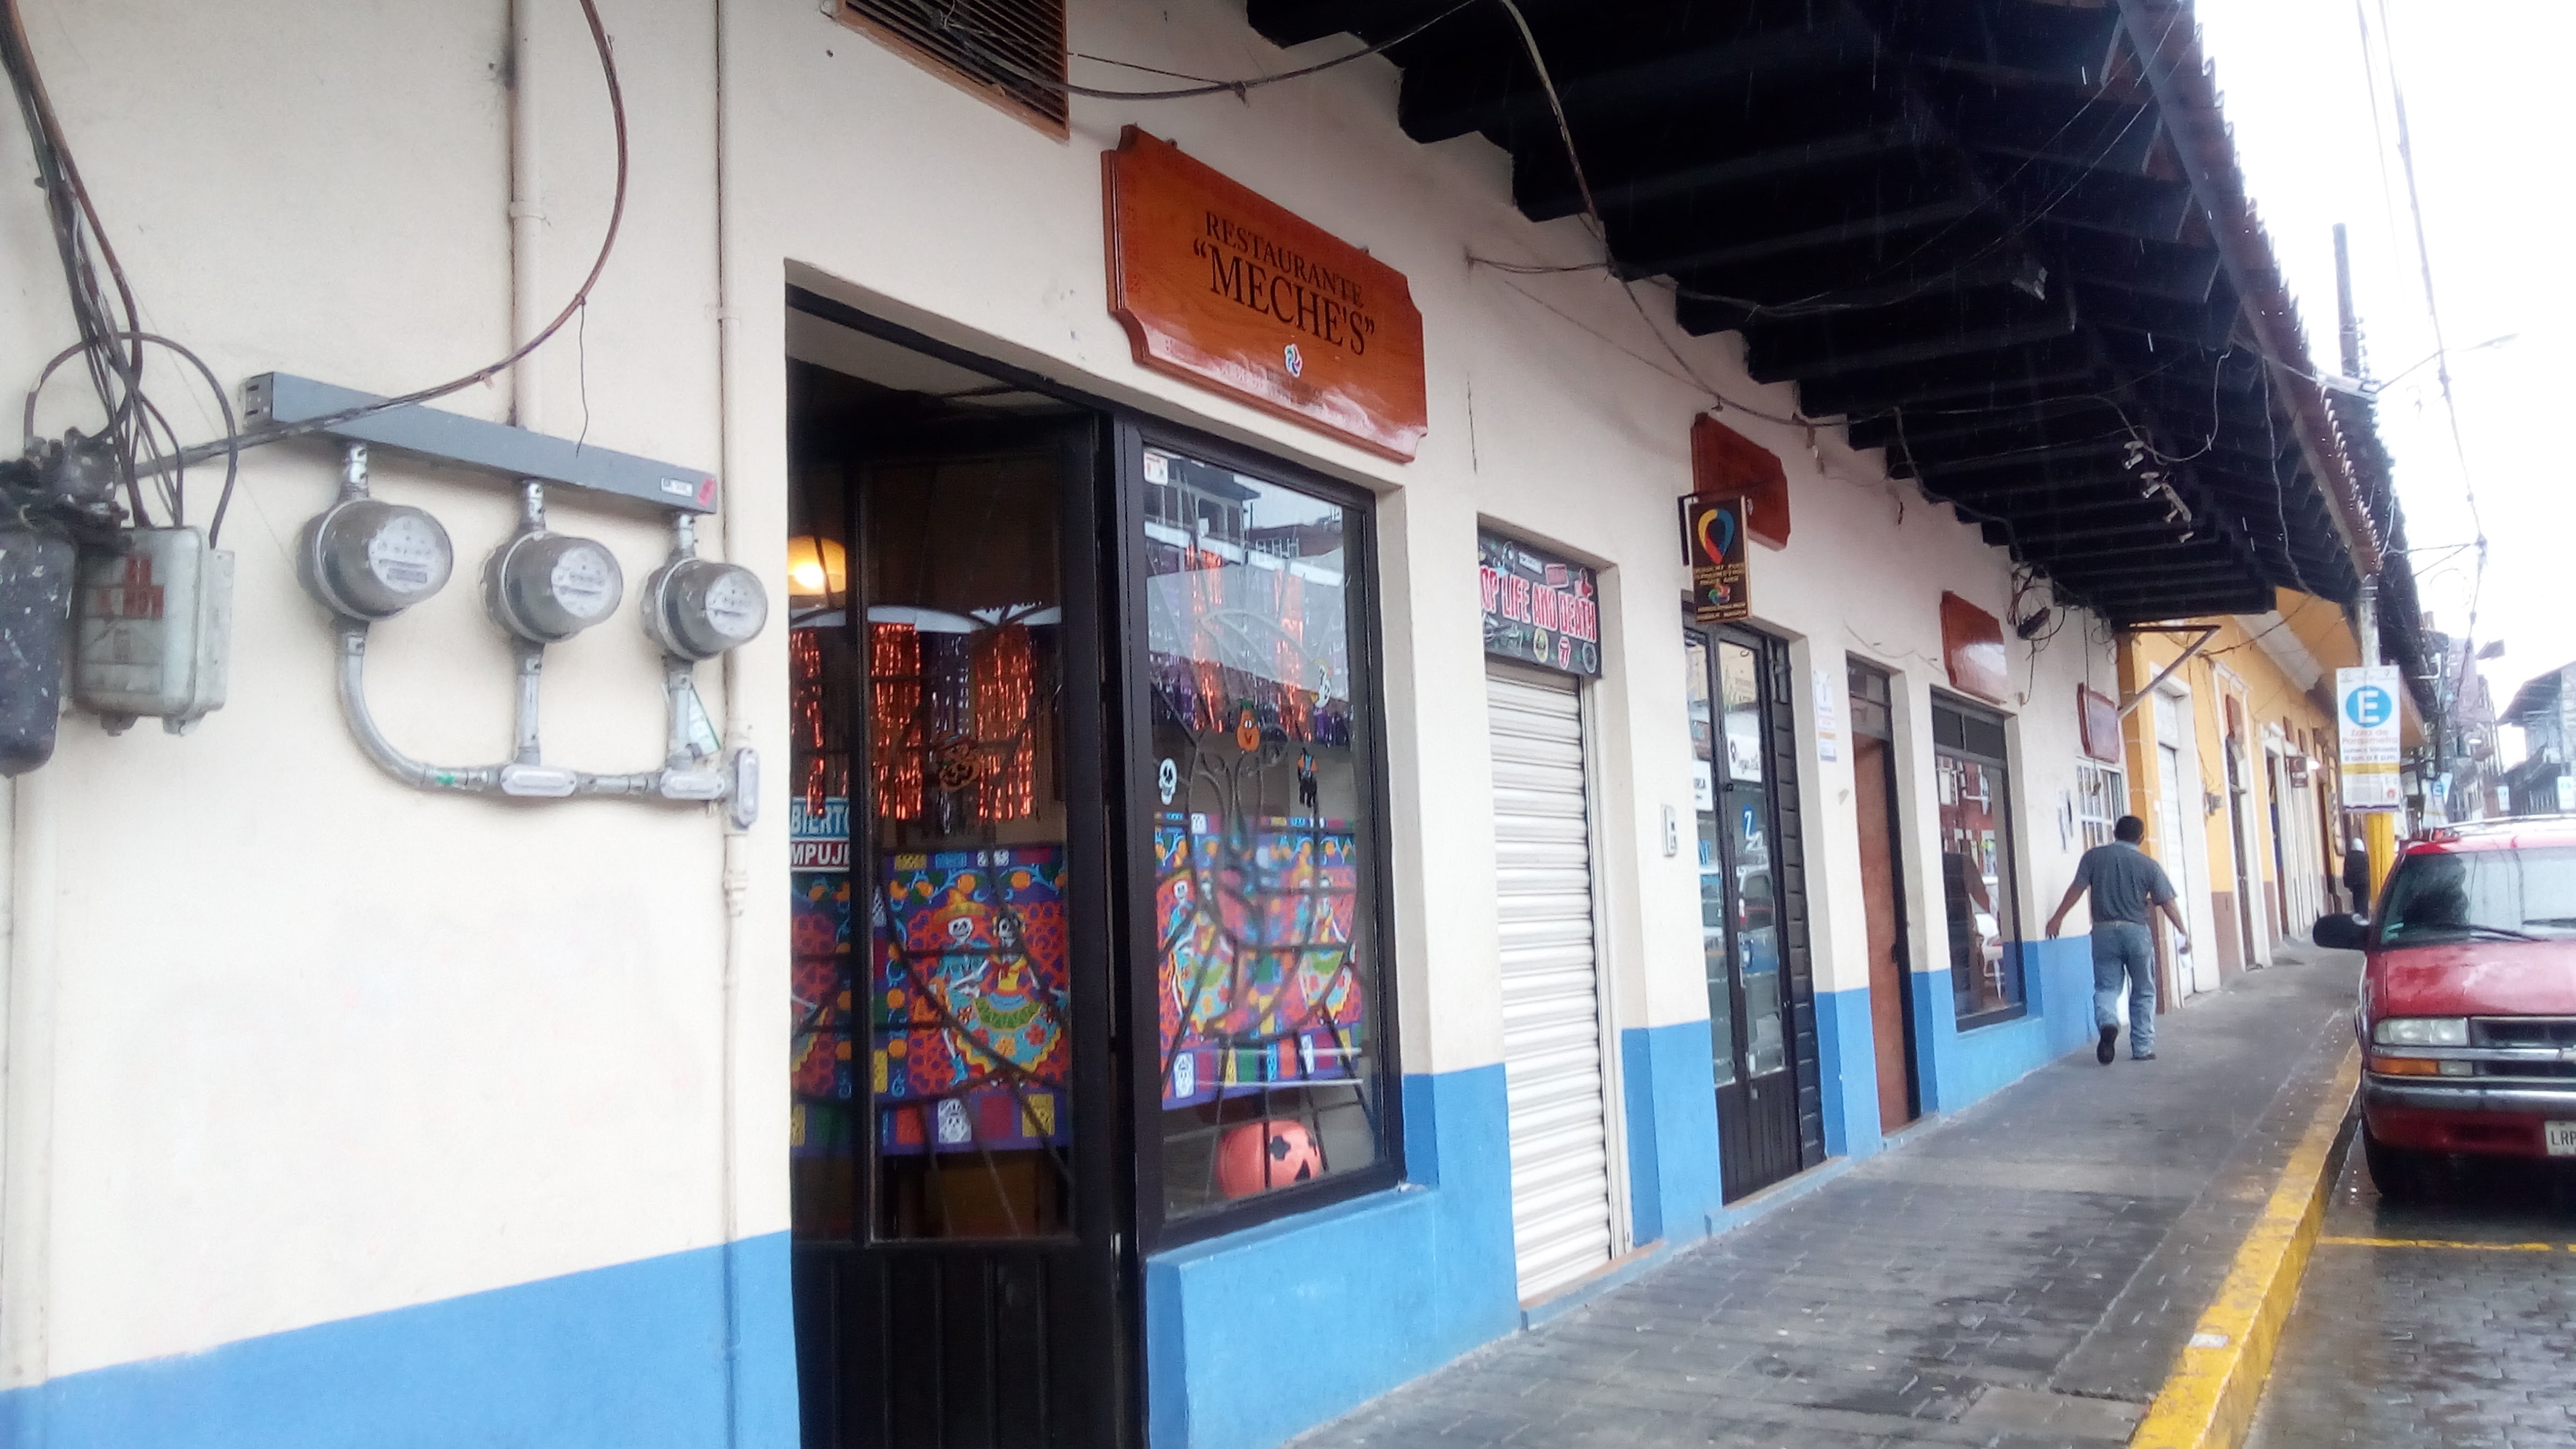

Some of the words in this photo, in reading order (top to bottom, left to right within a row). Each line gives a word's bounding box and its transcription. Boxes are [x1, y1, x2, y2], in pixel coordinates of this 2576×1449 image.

[1206, 210, 1364, 310] RESTAURANTE
[1501, 572, 1531, 625] LIFE
[1532, 581, 1557, 631] AND
[1557, 590, 1597, 643] DEATH
[2357, 690, 2380, 723] E
